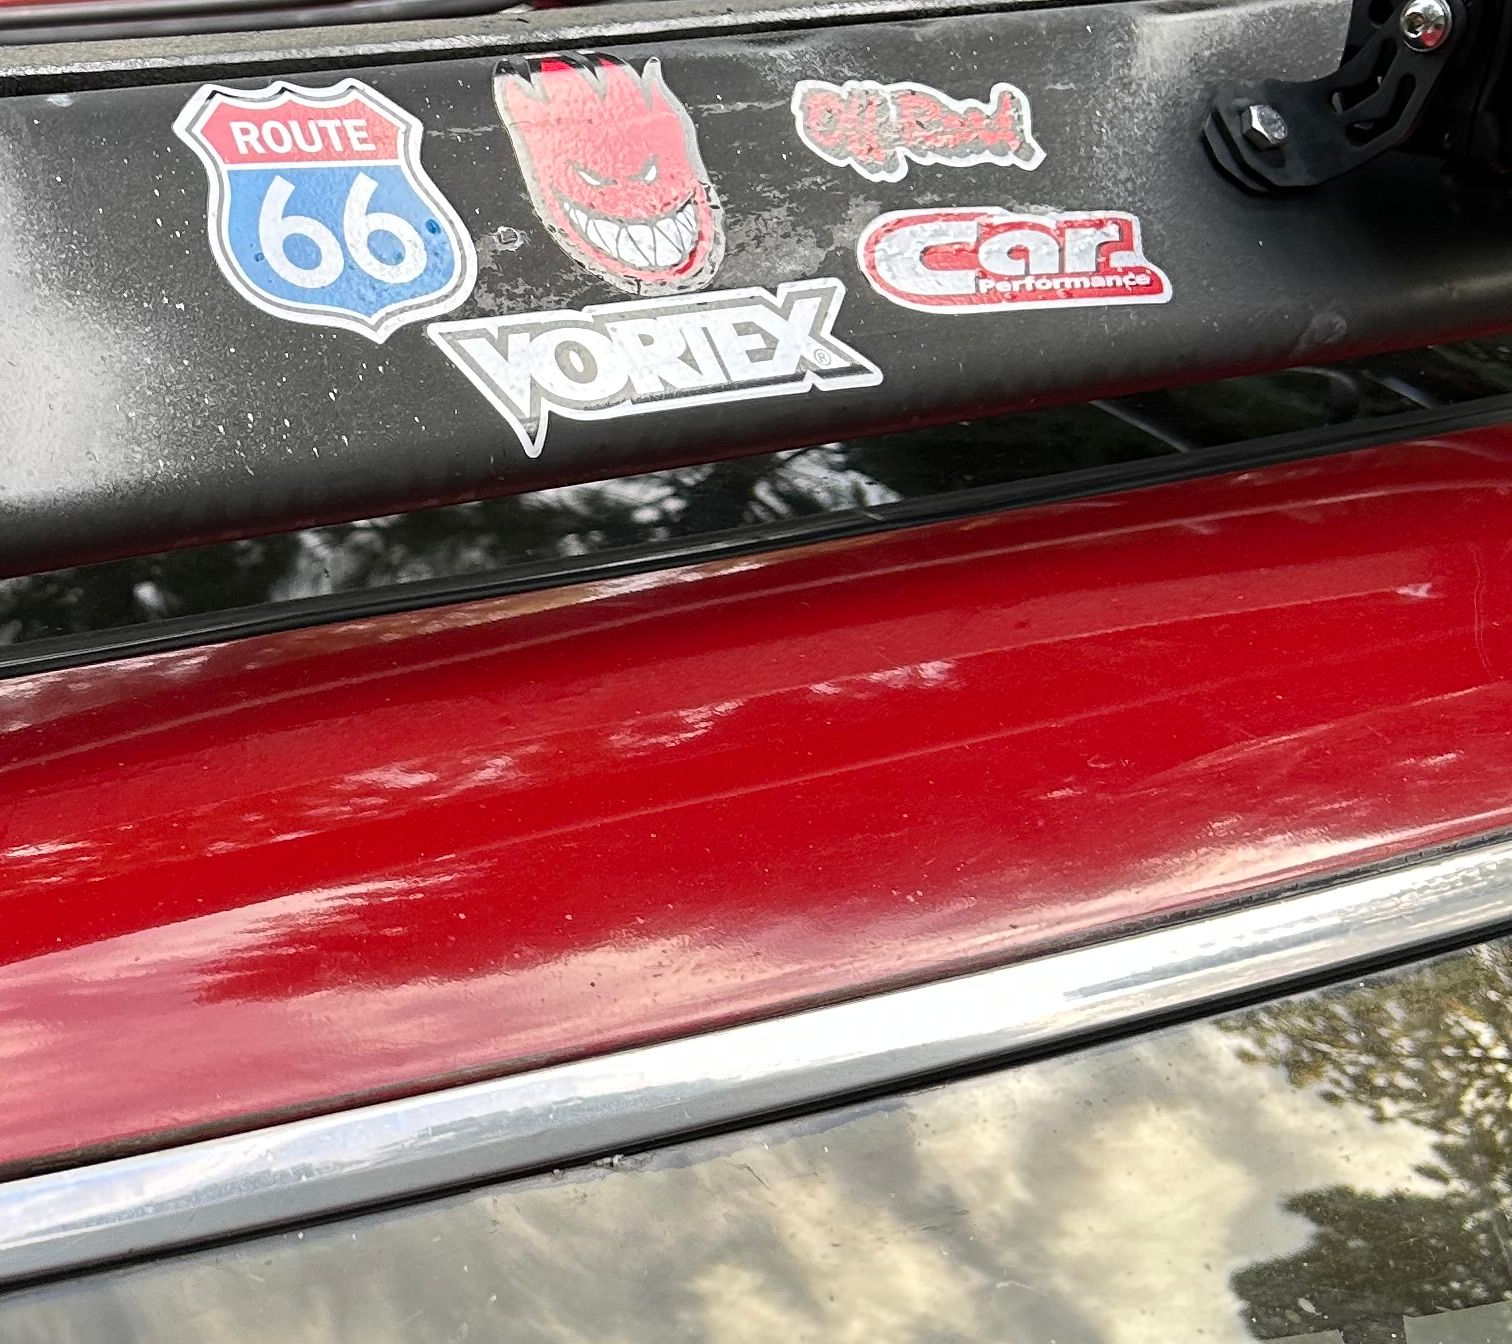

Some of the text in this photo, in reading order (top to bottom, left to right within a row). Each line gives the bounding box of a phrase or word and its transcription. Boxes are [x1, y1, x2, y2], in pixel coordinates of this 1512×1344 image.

[229, 118, 377, 156] ROUTE
[258, 171, 429, 289] 66
[979, 272, 1152, 294] Performance
[456, 296, 855, 421] VORTEX
